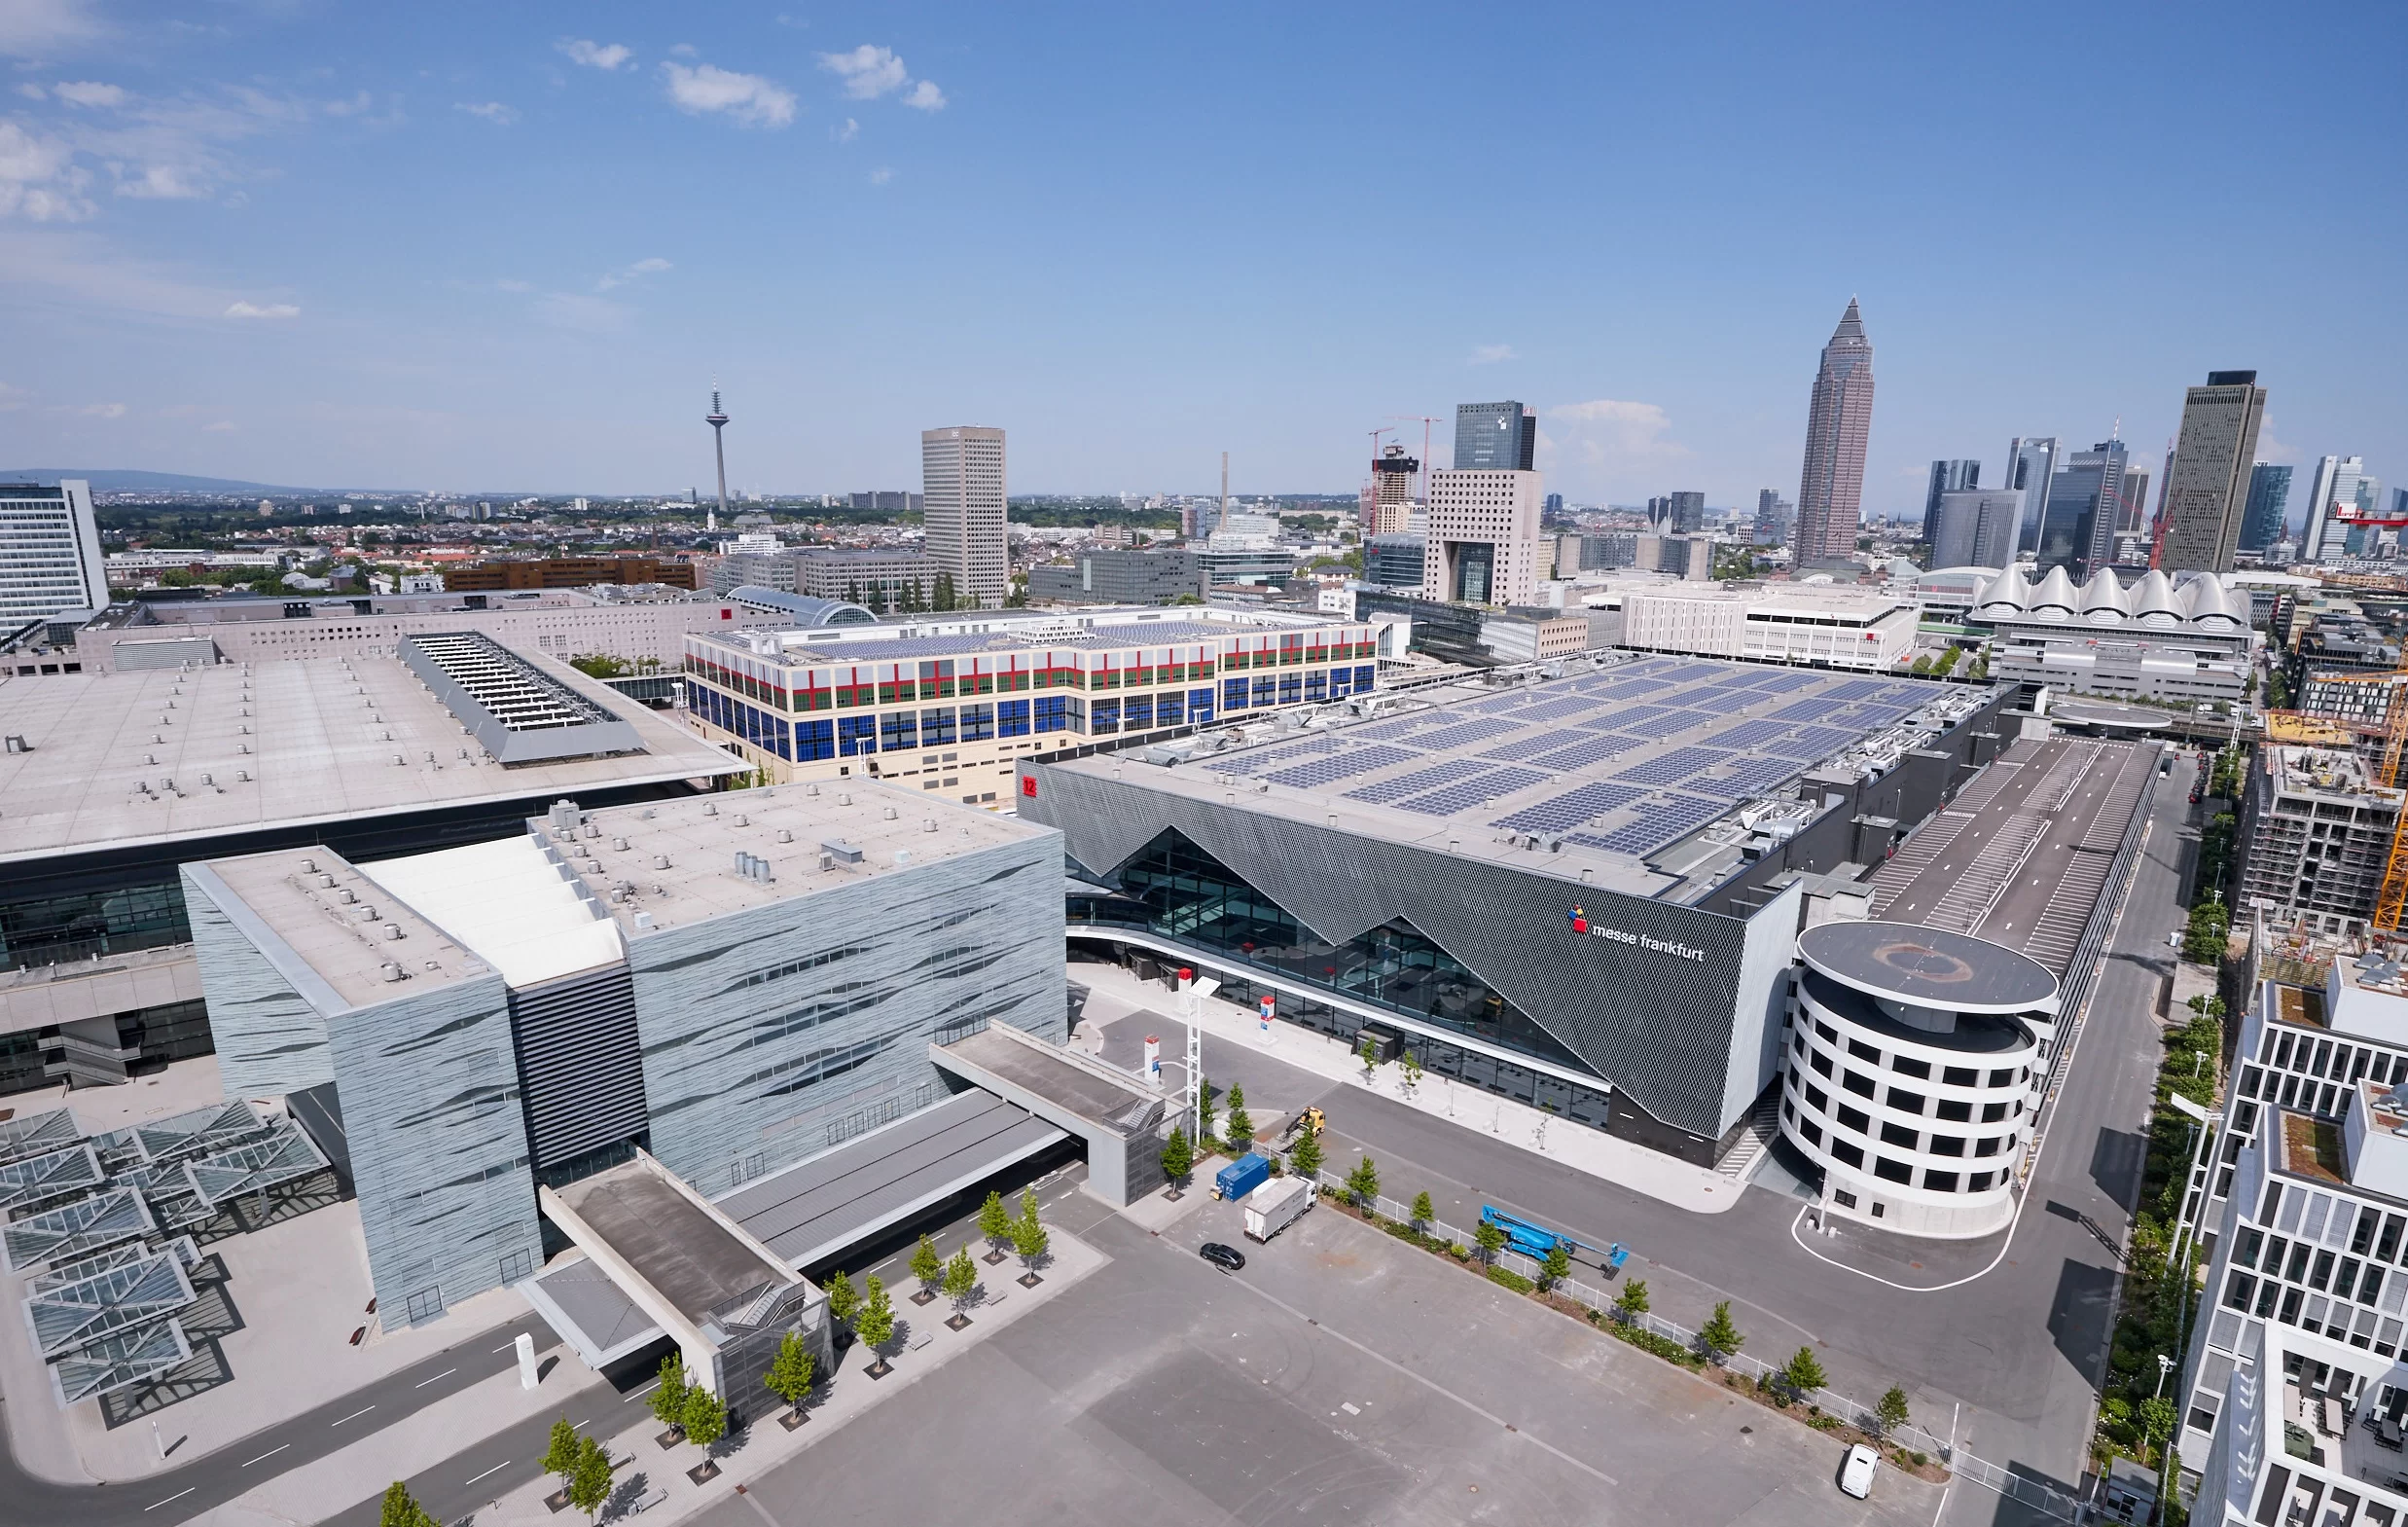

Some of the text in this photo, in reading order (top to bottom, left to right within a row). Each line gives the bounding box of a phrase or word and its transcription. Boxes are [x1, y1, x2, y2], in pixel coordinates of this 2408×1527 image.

[1024, 780, 1034, 793] 12
[1593, 926, 1704, 963] messe frankfurt
